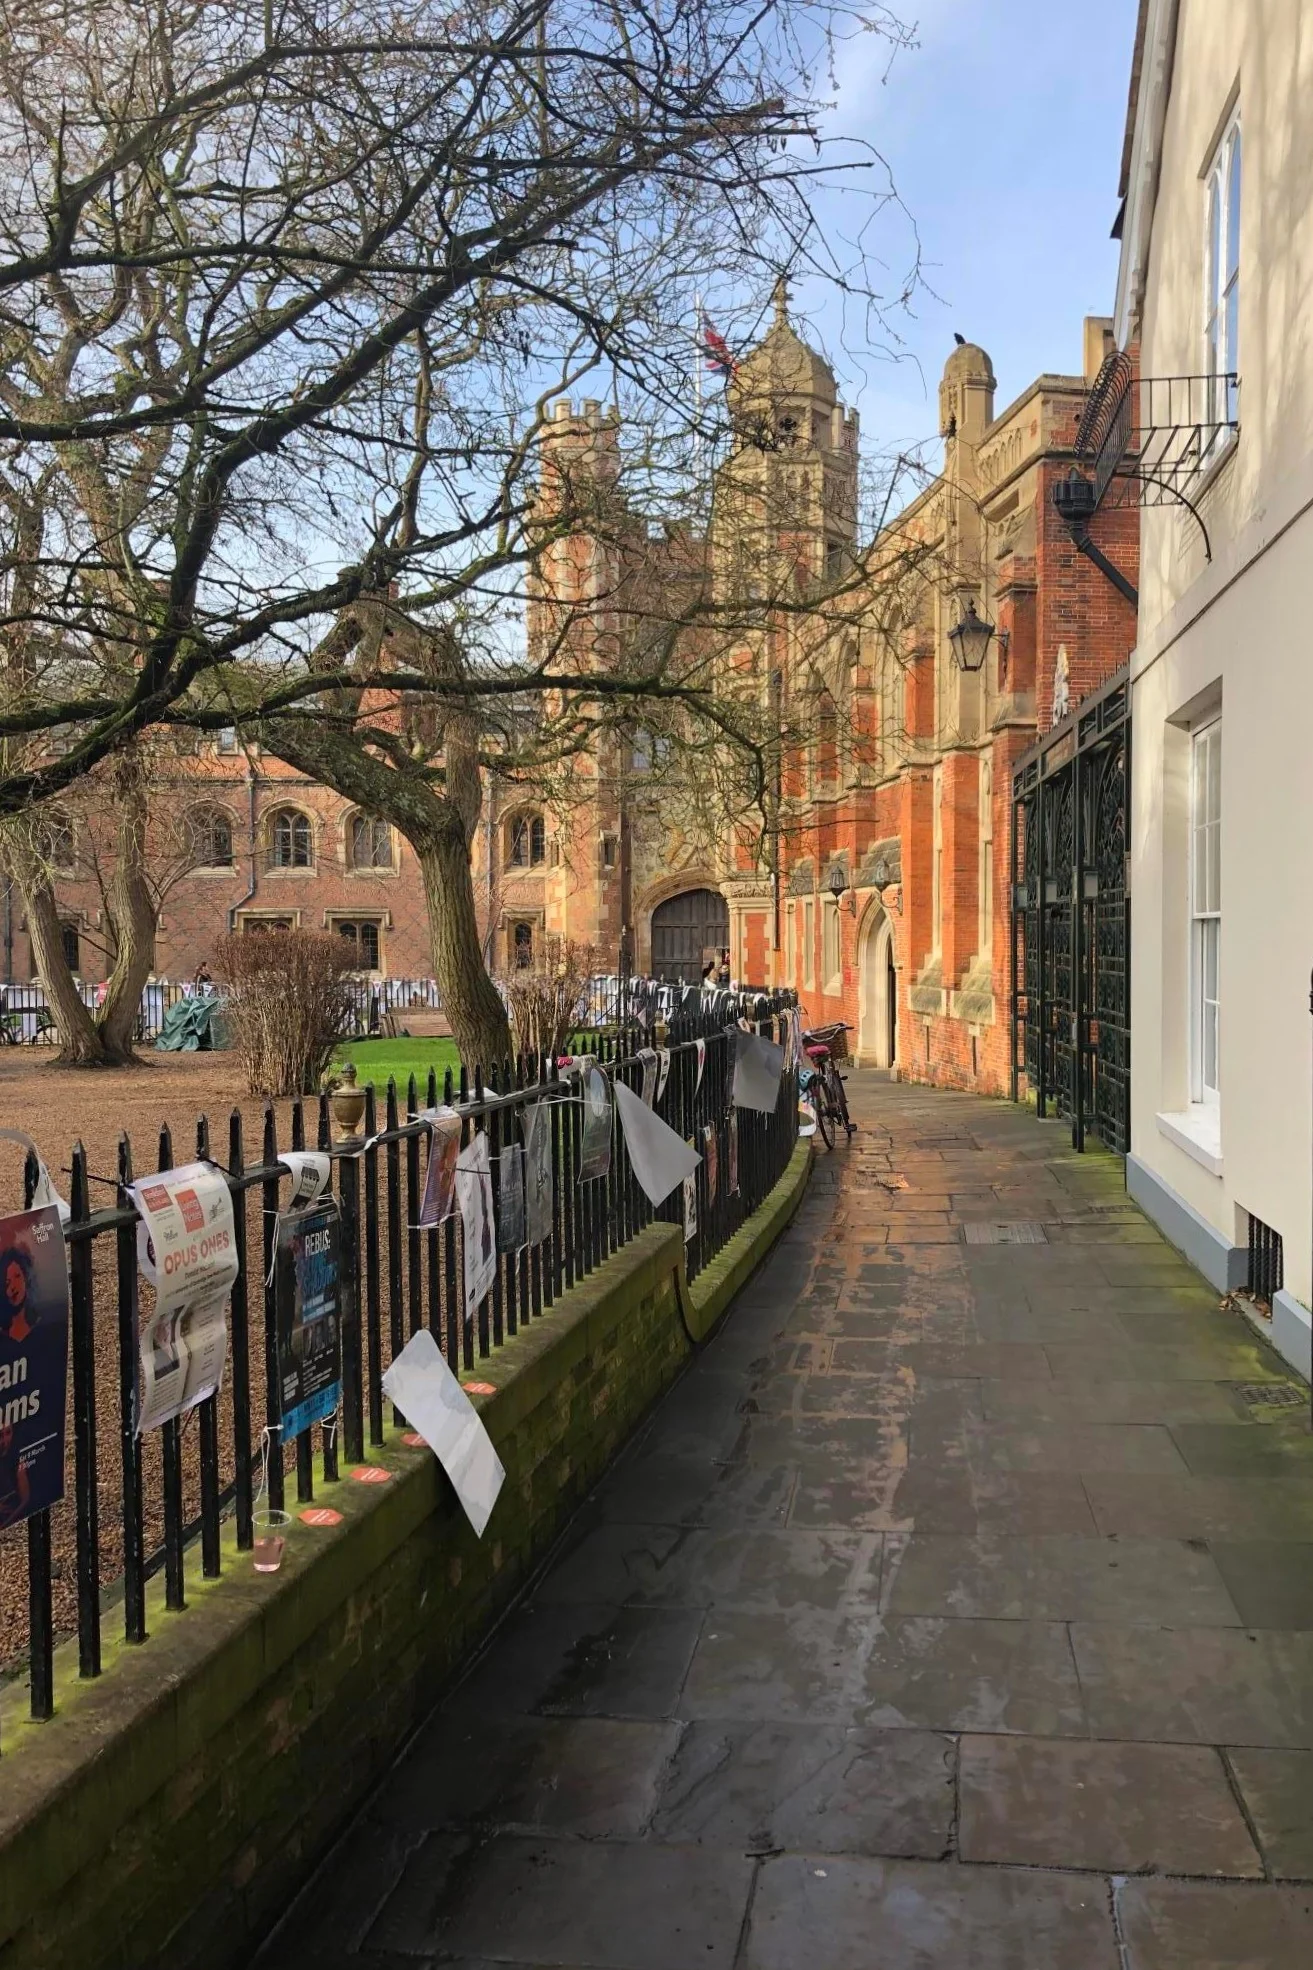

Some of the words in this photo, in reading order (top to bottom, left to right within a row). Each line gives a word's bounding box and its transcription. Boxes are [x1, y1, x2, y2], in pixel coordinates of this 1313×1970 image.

[32, 1222, 54, 1235] Saffron
[36, 1232, 50, 1243] Hall
[164, 1244, 198, 1275] OPUS
[200, 1230, 230, 1258] ONES
[0, 1389, 40, 1430] ms
